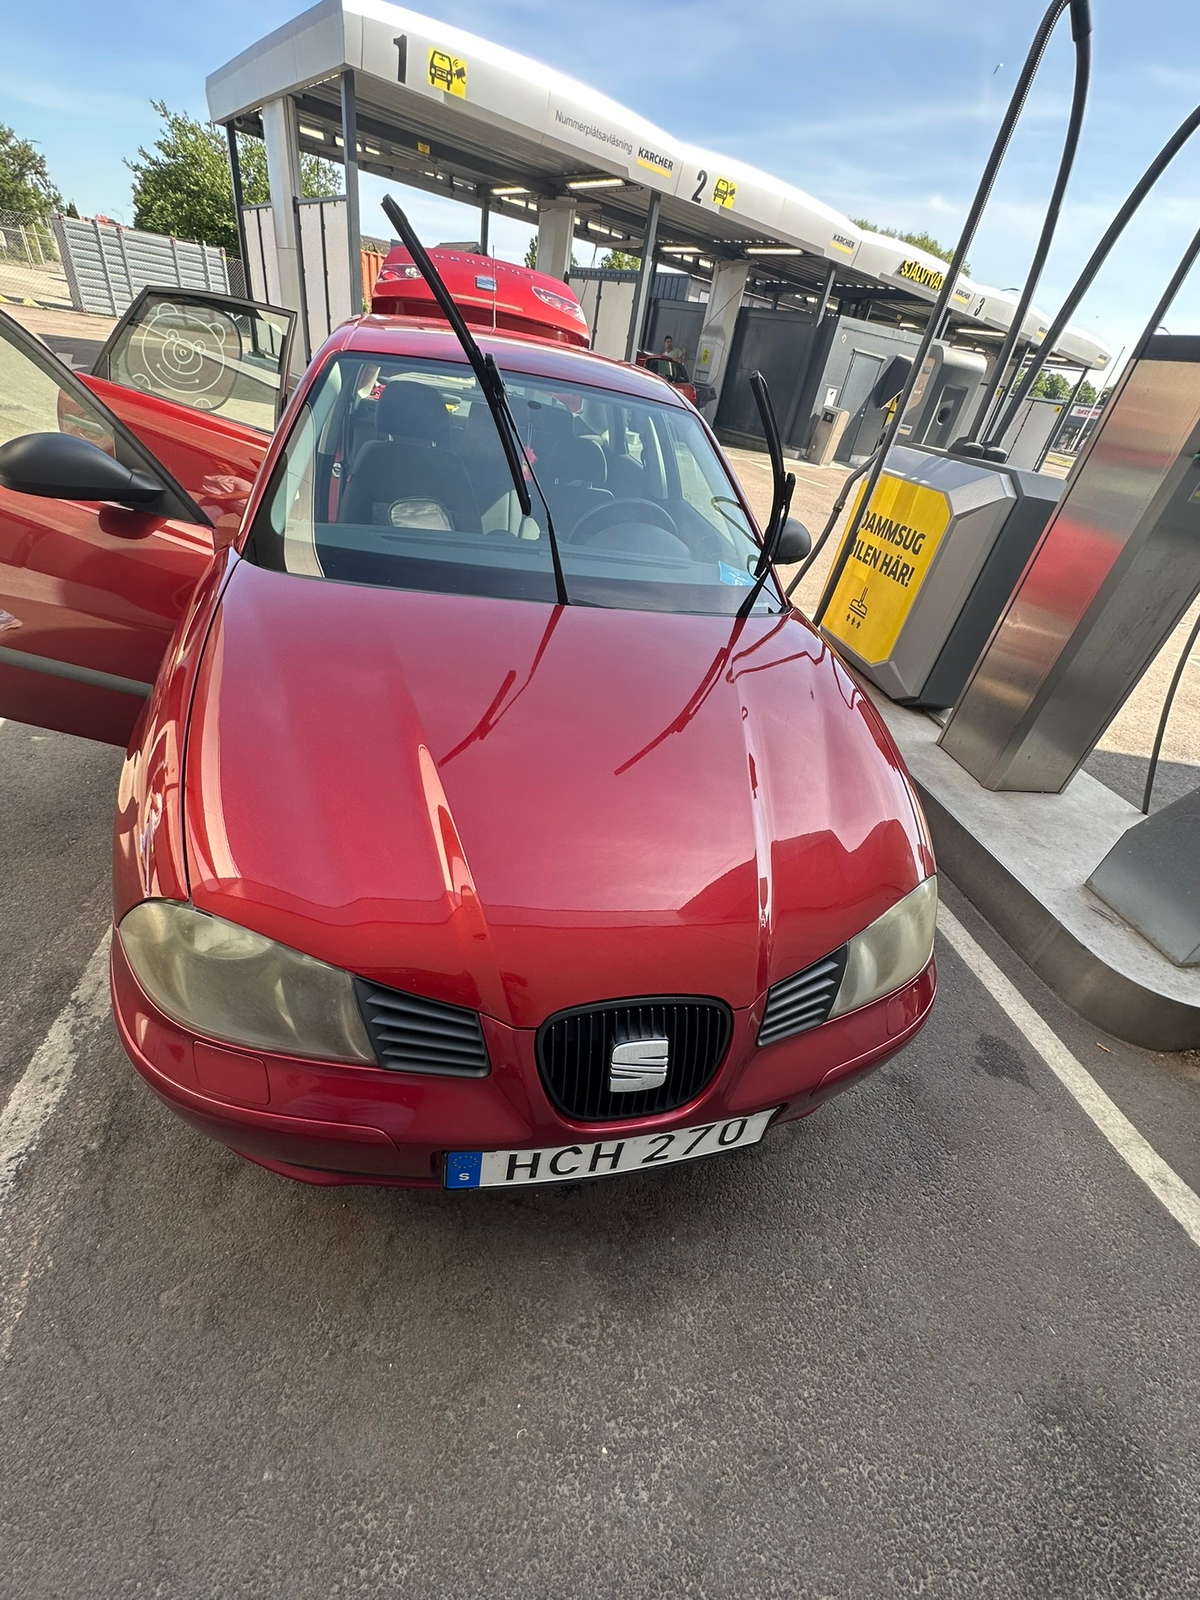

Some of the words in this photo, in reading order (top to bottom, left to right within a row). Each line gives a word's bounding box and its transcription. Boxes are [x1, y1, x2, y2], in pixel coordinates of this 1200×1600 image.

[393, 33, 407, 84] 1
[555, 109, 633, 155] Nummerplåtsavläsning
[637, 146, 674, 171] KÄRCHER
[691, 170, 708, 203] 2
[974, 297, 985, 316] 3
[879, 554, 915, 588] HÄR!
[505, 1142, 625, 1180] HCH
[642, 1118, 749, 1163] 270
[458, 1172, 470, 1181] S
